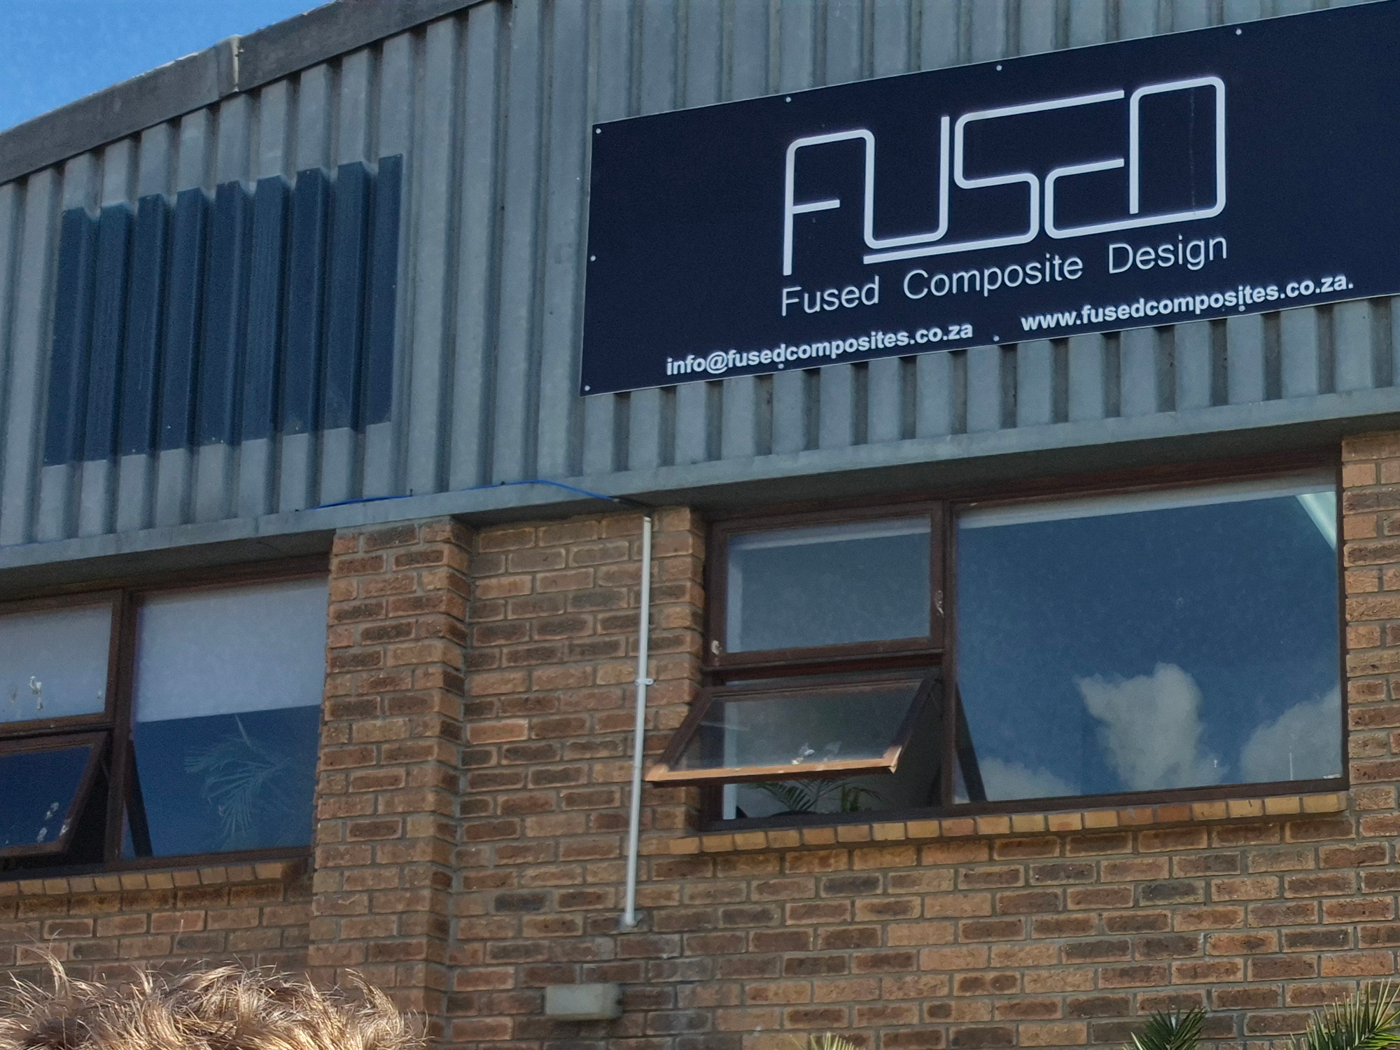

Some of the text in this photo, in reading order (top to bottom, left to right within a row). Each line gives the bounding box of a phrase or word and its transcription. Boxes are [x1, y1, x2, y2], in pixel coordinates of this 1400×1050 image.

[781, 233, 1228, 317] Fused Composite Design
[666, 322, 973, 375] info@fusedcomposites.co.za
